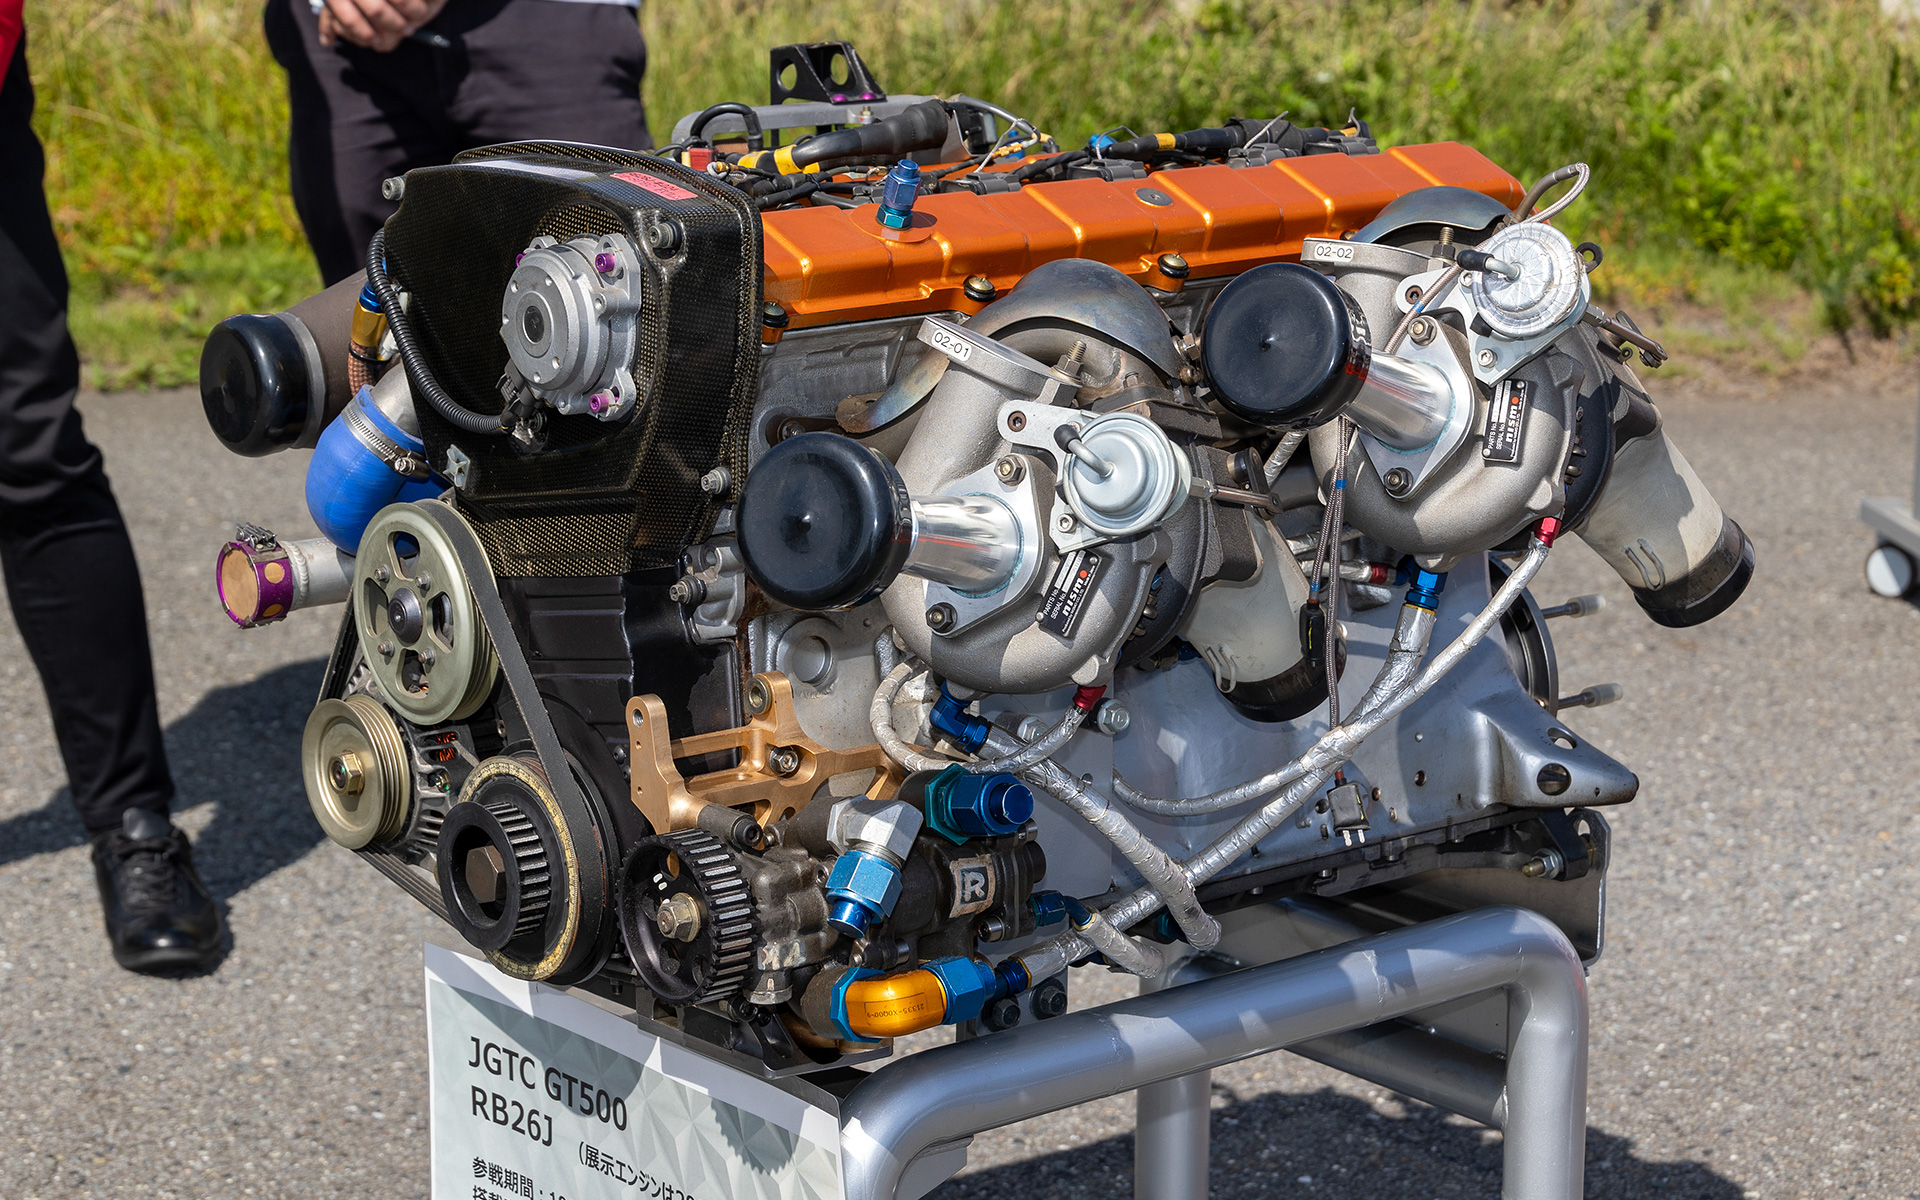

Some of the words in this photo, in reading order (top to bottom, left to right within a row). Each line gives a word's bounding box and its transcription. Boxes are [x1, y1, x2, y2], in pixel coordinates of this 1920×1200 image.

[1316, 245, 1353, 259] 02-02
[934, 332, 969, 358] 02-01
[1488, 431, 1496, 449] PARTS
[1496, 432, 1504, 450] SERIAL
[1043, 597, 1055, 615] PARTS
[1051, 601, 1063, 619] SERIAL
[963, 872, 985, 902] R
[468, 1036, 536, 1090] JGTC
[544, 1067, 627, 1131] GT500
[471, 1085, 553, 1147] RB26J
[579, 1141, 694, 1200] (展示エンジンは
